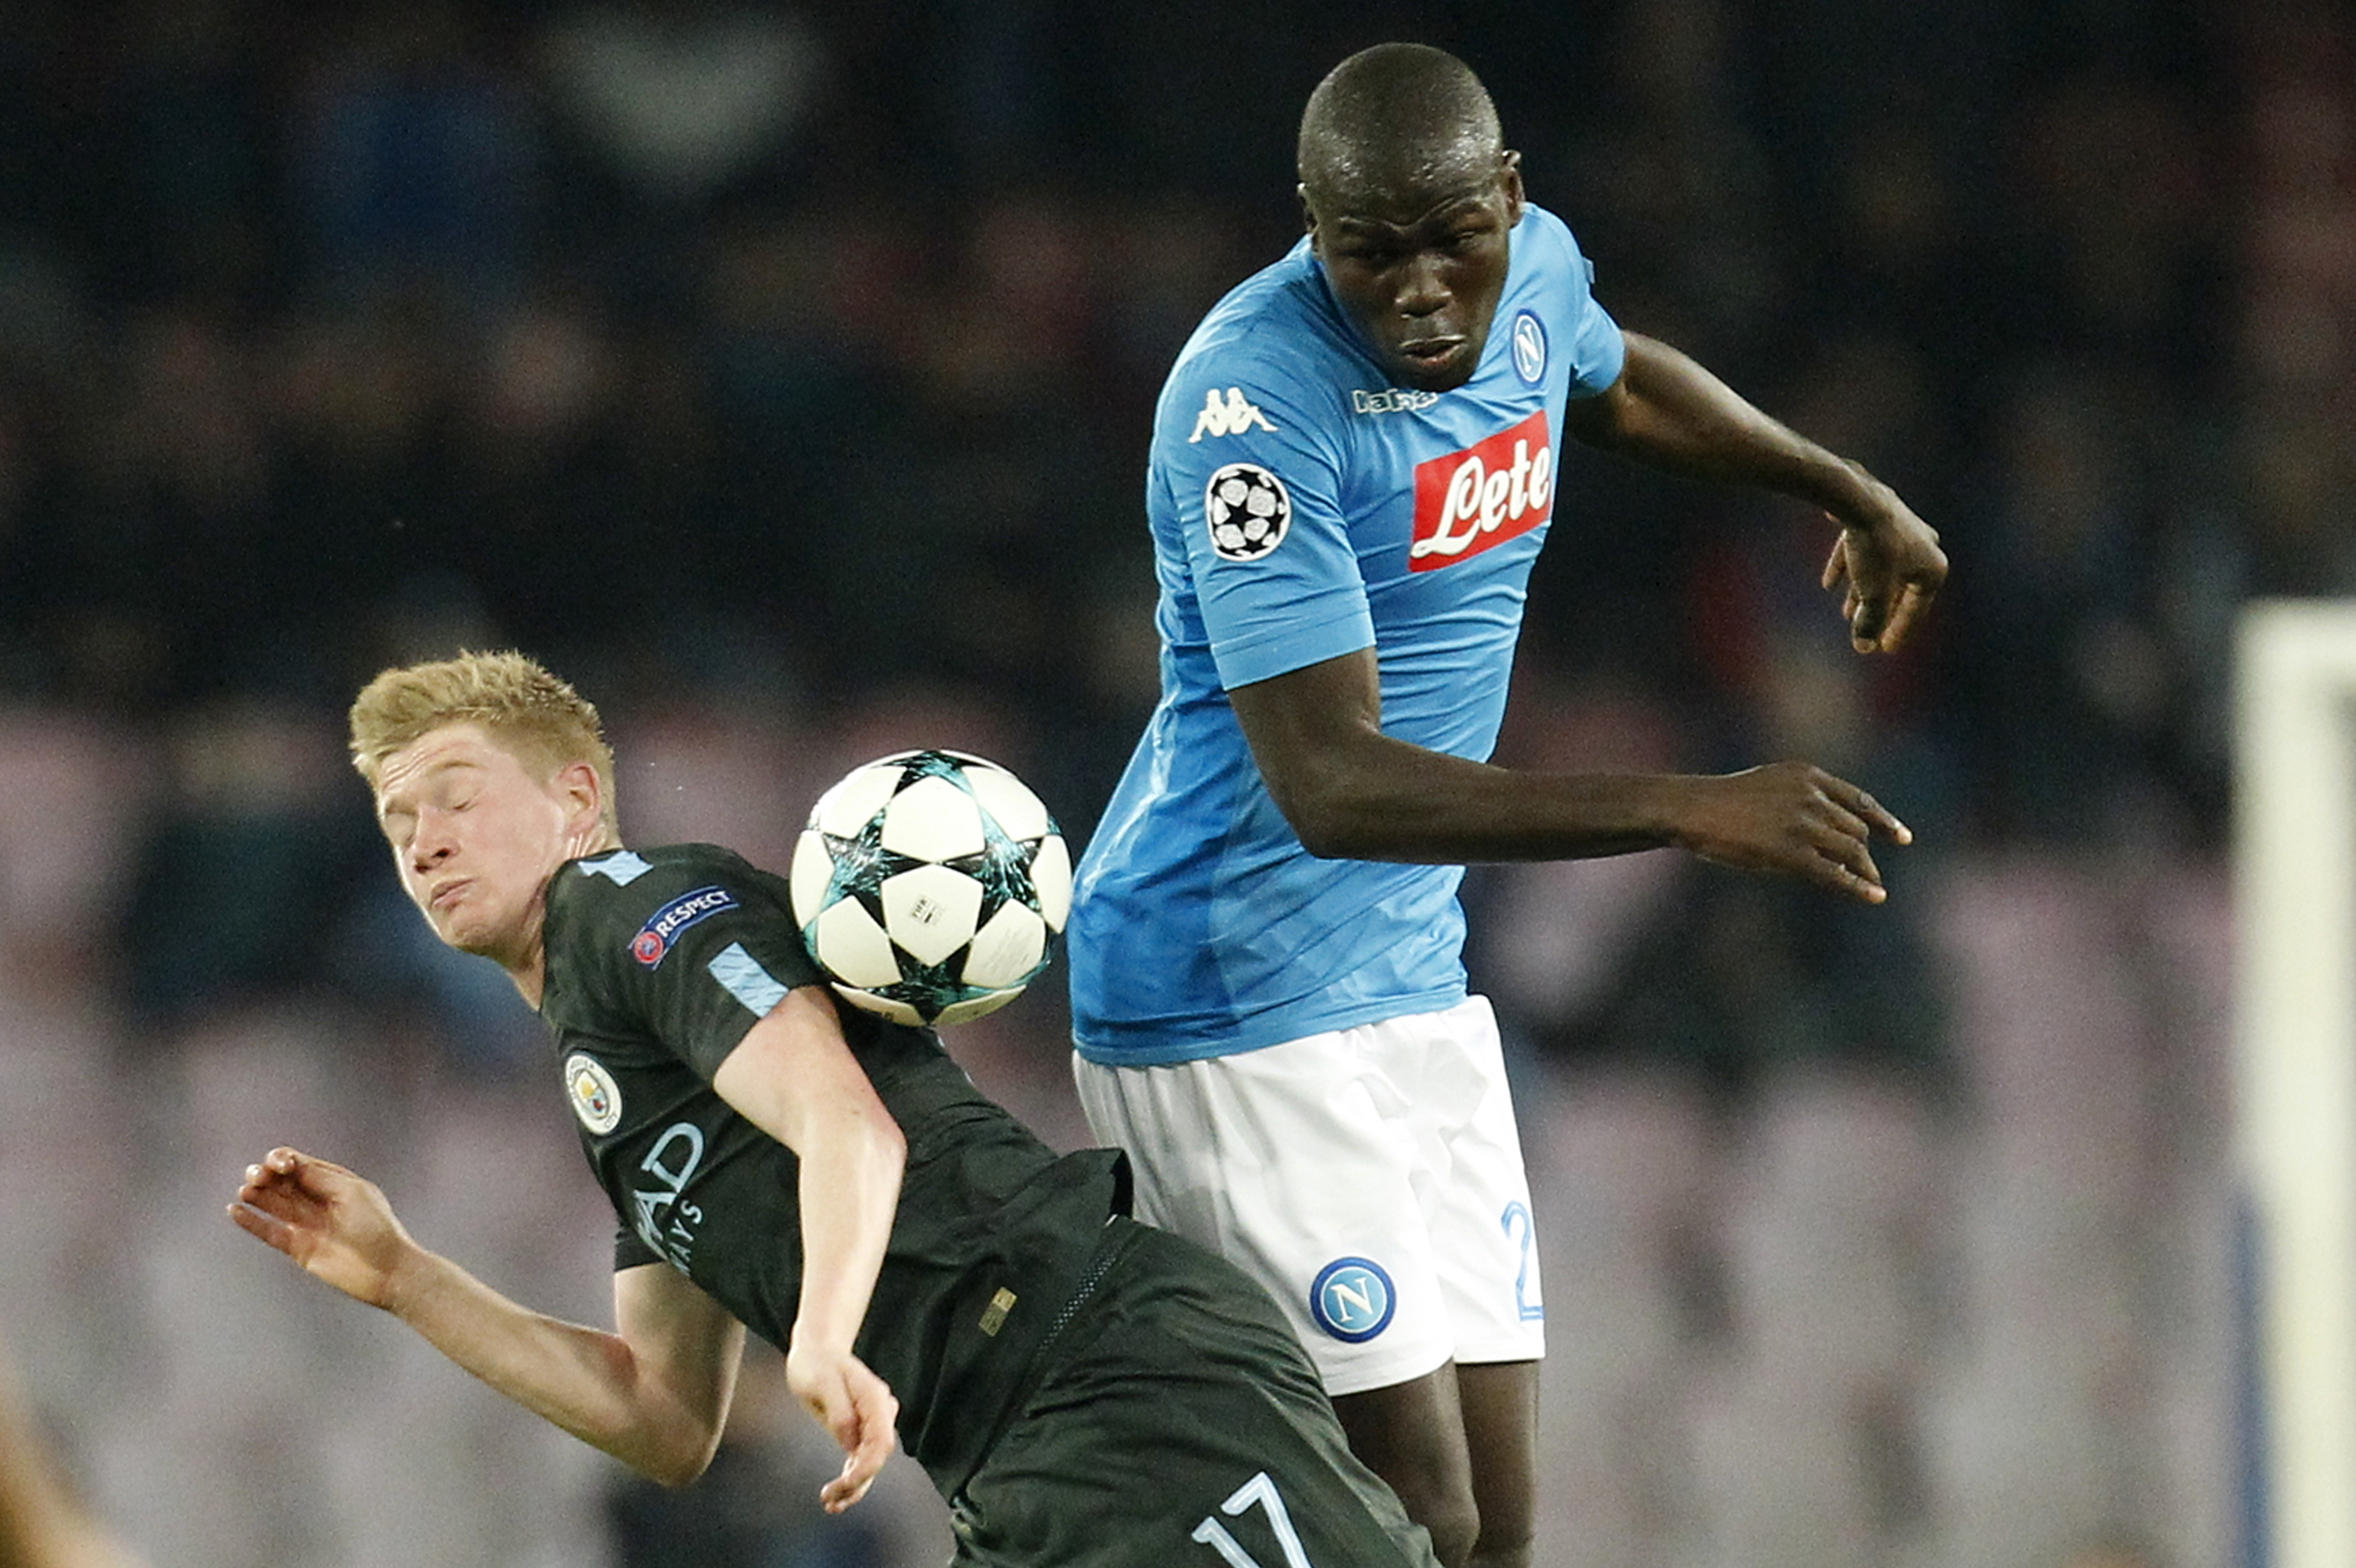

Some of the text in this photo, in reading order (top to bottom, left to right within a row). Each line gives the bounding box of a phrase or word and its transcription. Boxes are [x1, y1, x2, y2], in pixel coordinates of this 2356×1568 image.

[1516, 324, 1540, 373] N
[1410, 439, 1551, 559] Lete
[655, 890, 731, 937] RESPECT
[633, 1122, 704, 1261] AD
[1330, 1277, 1374, 1323] N
[1191, 1470, 1314, 1568] 17
